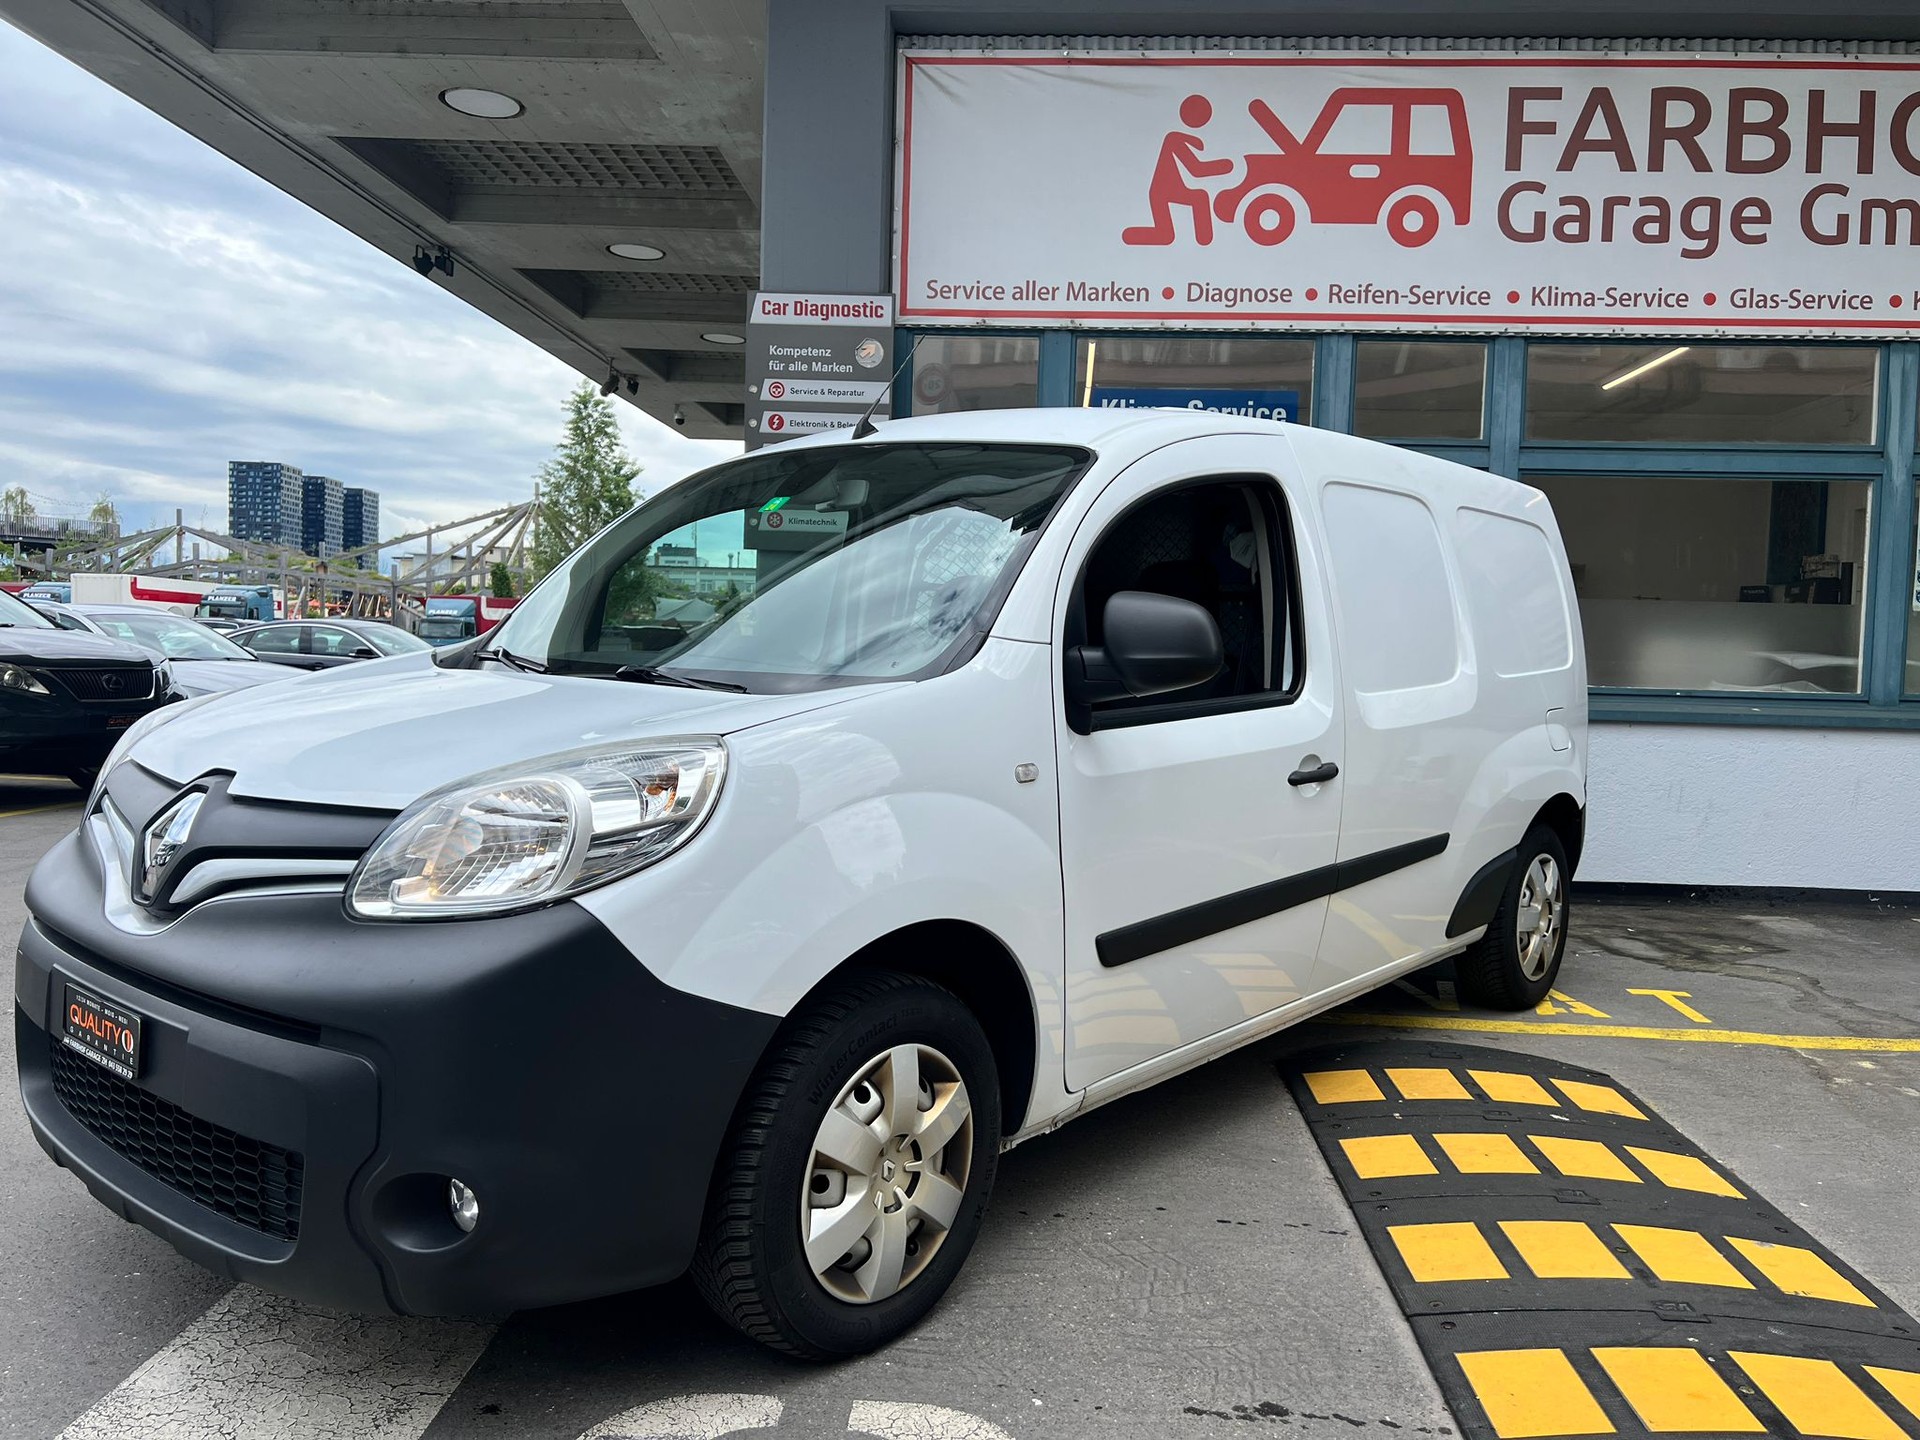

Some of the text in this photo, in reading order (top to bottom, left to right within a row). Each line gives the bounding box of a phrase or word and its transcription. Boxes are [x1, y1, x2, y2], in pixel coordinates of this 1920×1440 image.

[1497, 180, 1772, 259] Garage
[925, 280, 1150, 303] Service aller Marken
[1186, 282, 1293, 308] Diagnose
[1328, 283, 1491, 307] Reifen-Service
[1530, 285, 1689, 309] Klima-Service
[1729, 288, 1874, 311] Glas-Service
[761, 299, 885, 321] Car Diagnostic
[769, 345, 832, 359] Kompetenz
[768, 360, 853, 373] für alle Marken
[790, 387, 866, 399] Service & Reparatur
[789, 420, 828, 429] Elektronik
[788, 517, 838, 527] Klimatechnik
[70, 1003, 122, 1045] QUALITY
[69, 1025, 134, 1065] GARANTIE
[808, 1012, 898, 1106] WinterContact
